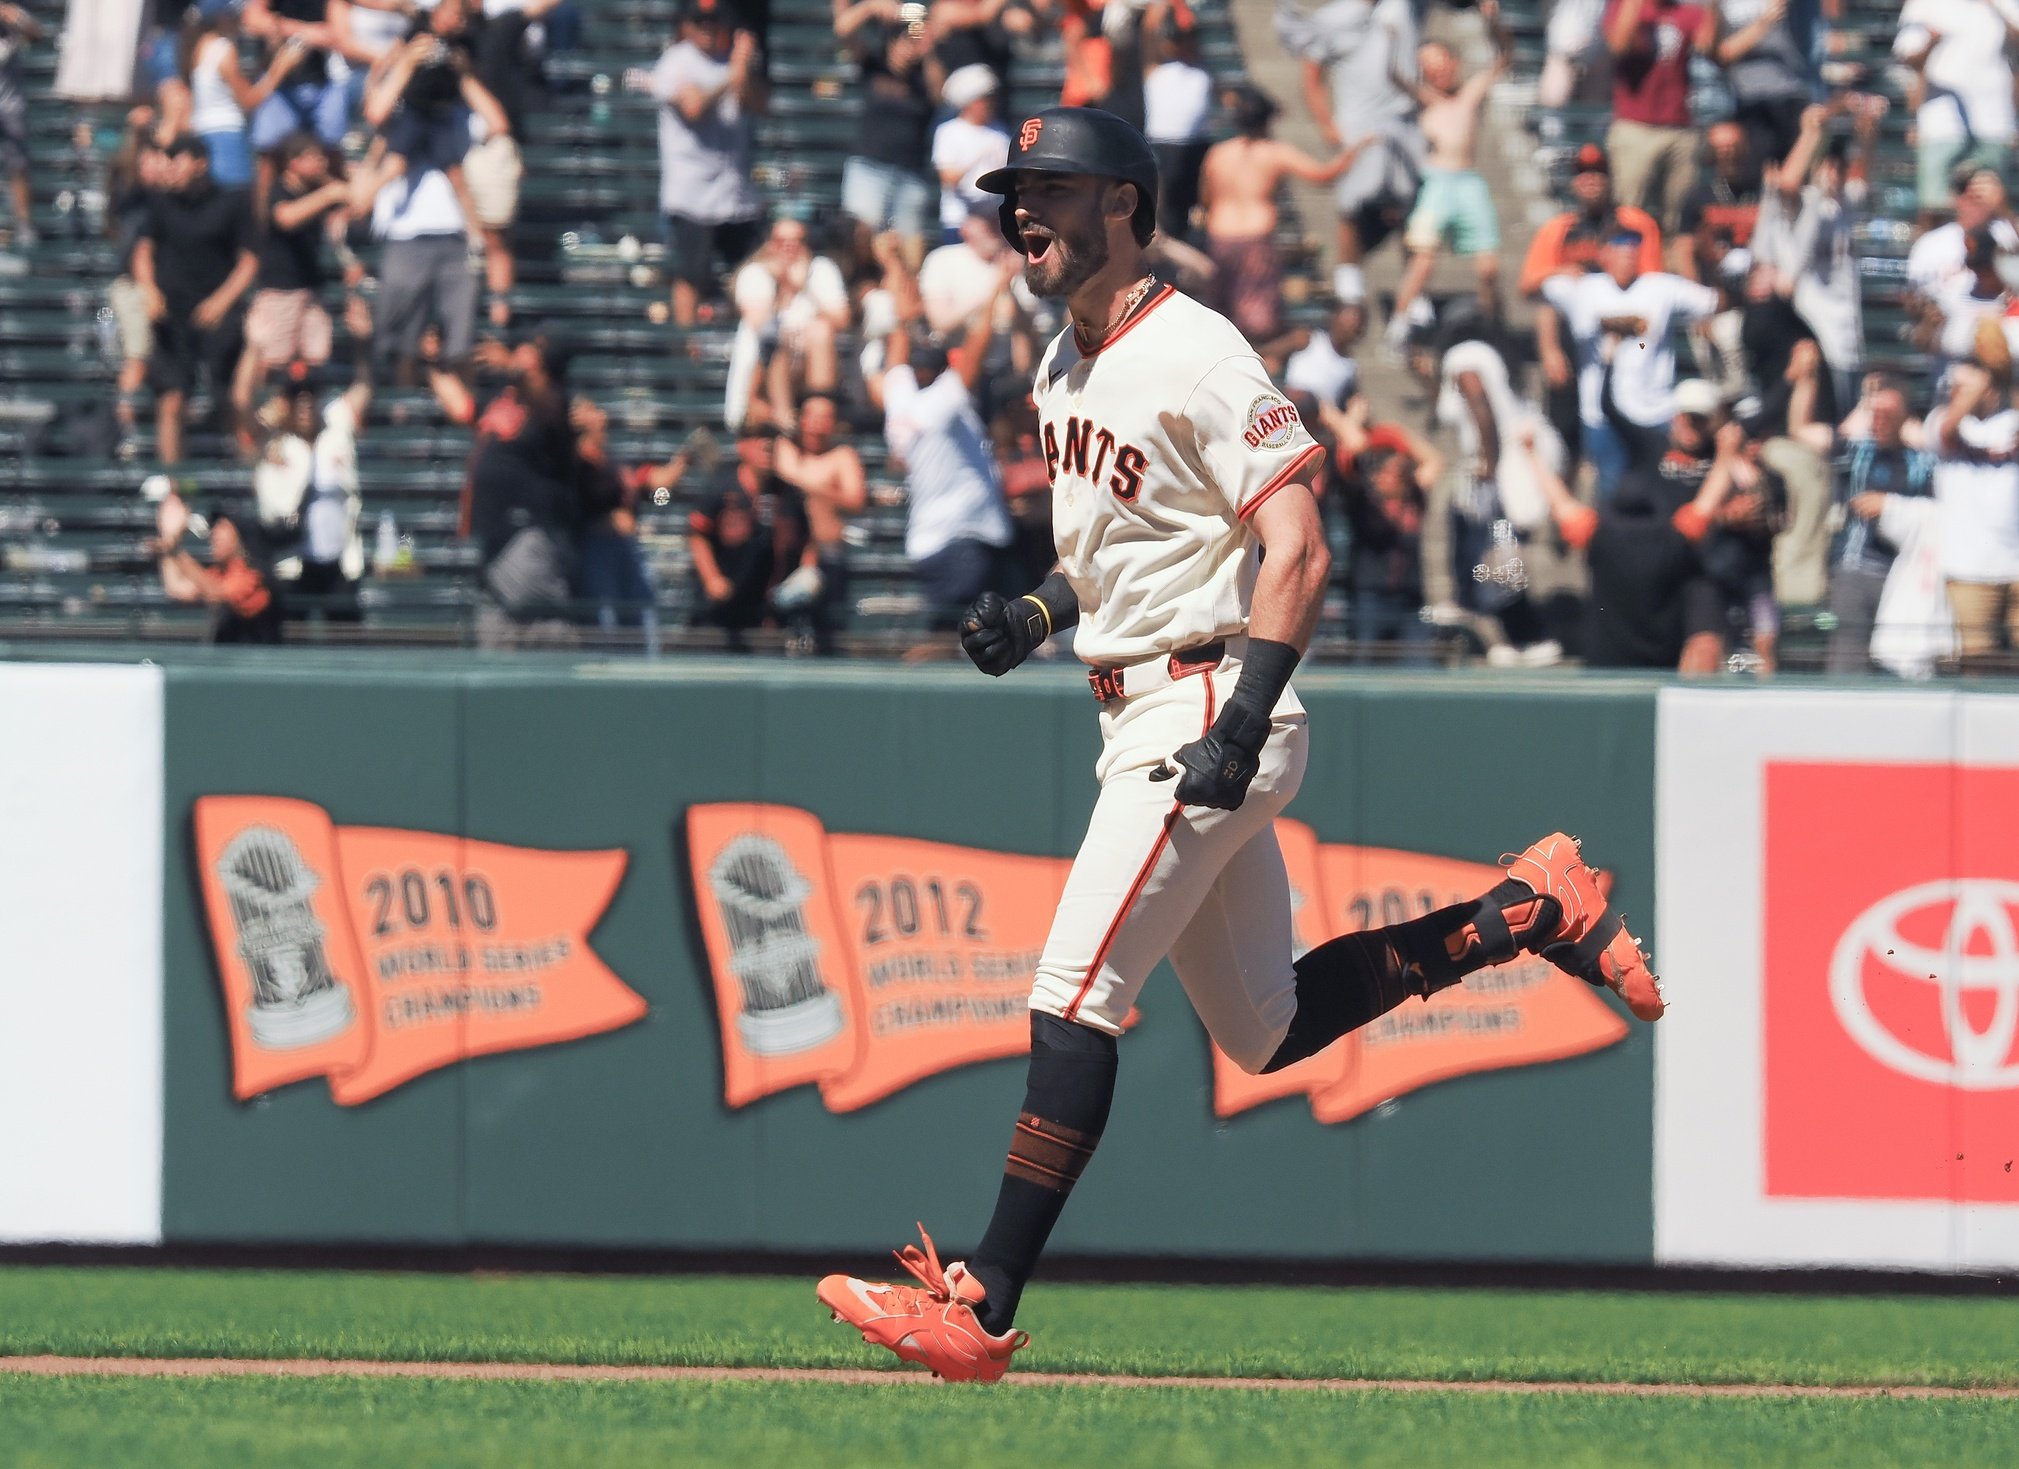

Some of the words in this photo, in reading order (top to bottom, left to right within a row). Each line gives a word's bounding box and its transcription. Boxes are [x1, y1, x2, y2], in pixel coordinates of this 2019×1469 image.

[1019, 118, 1042, 152] SF
[1244, 405, 1298, 448] GIANTS
[367, 871, 497, 936] 2010
[855, 876, 987, 944] 2012
